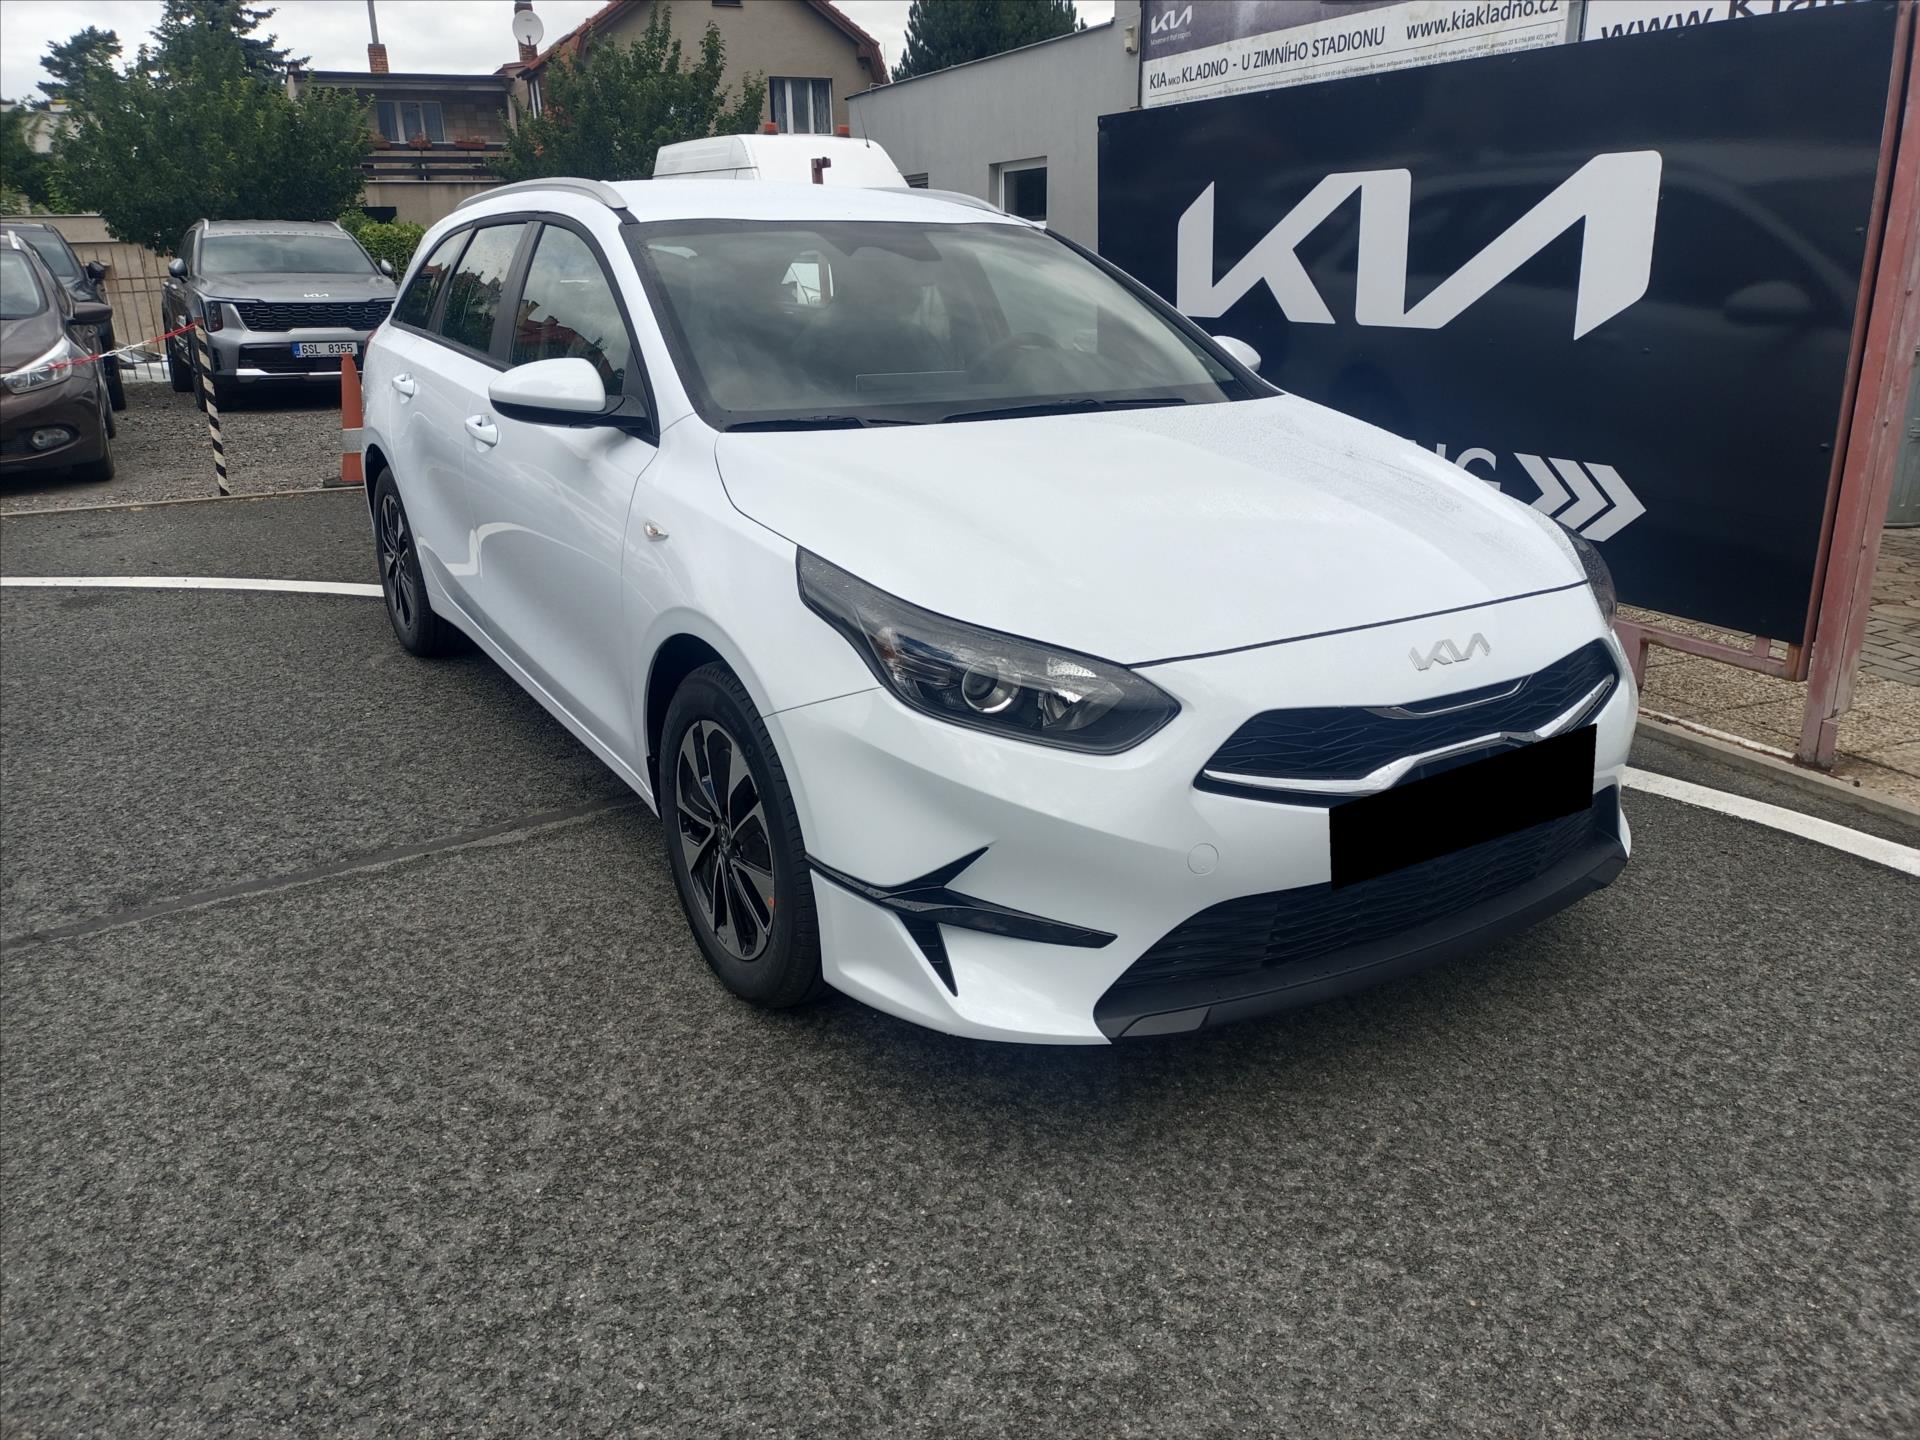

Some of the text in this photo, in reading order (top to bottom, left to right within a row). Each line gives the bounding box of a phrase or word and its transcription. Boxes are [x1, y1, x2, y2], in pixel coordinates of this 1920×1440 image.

[1151, 5, 1192, 34] KIA
[1149, 72, 1167, 89] KIA
[1168, 76, 1181, 86] MKD
[1181, 58, 1229, 83] KLADNO
[1241, 53, 1251, 70] U
[1253, 41, 1308, 68] ZIMNÍHO
[1312, 26, 1385, 58] STADIONU
[1406, 0, 1558, 40] www.kiakladno.cz
[1177, 150, 1663, 340] KIA
[302, 344, 354, 354] 6SL 8355
[1408, 632, 1491, 671] KIA
